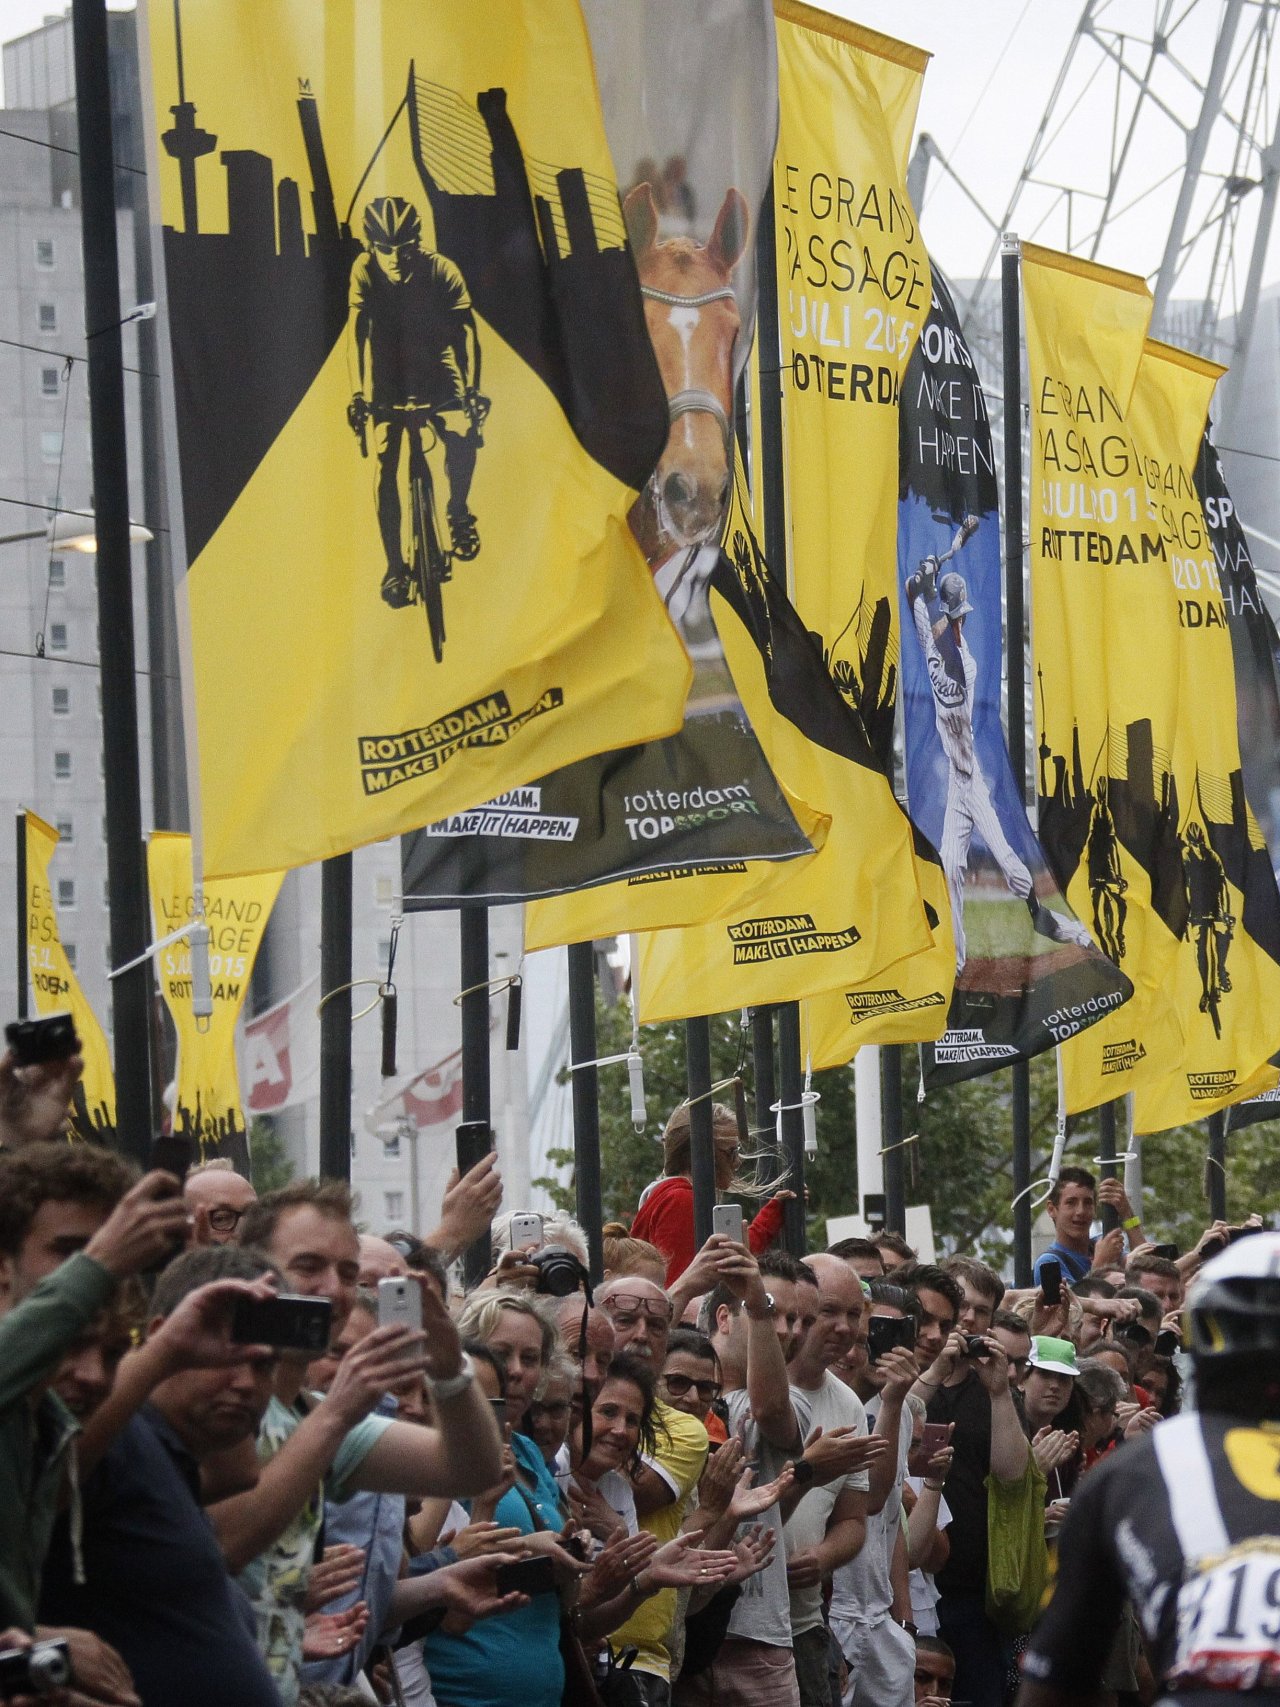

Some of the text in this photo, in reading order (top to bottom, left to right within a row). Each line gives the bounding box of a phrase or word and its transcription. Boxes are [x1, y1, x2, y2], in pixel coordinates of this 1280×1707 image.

[362, 698, 508, 762] ROTTERDAM.
[365, 756, 436, 793] MAKE
[624, 786, 751, 813] rotterdam
[482, 816, 500, 833] IT
[505, 817, 573, 838] HAPPEN.
[729, 917, 813, 939] ROTTERDAM.
[736, 932, 858, 962] MAKE IT HAPPEN.
[1042, 990, 1124, 1027] rotterdam
[937, 1049, 957, 1063] MAKE
[970, 1046, 1017, 1059] HAPPEN.
